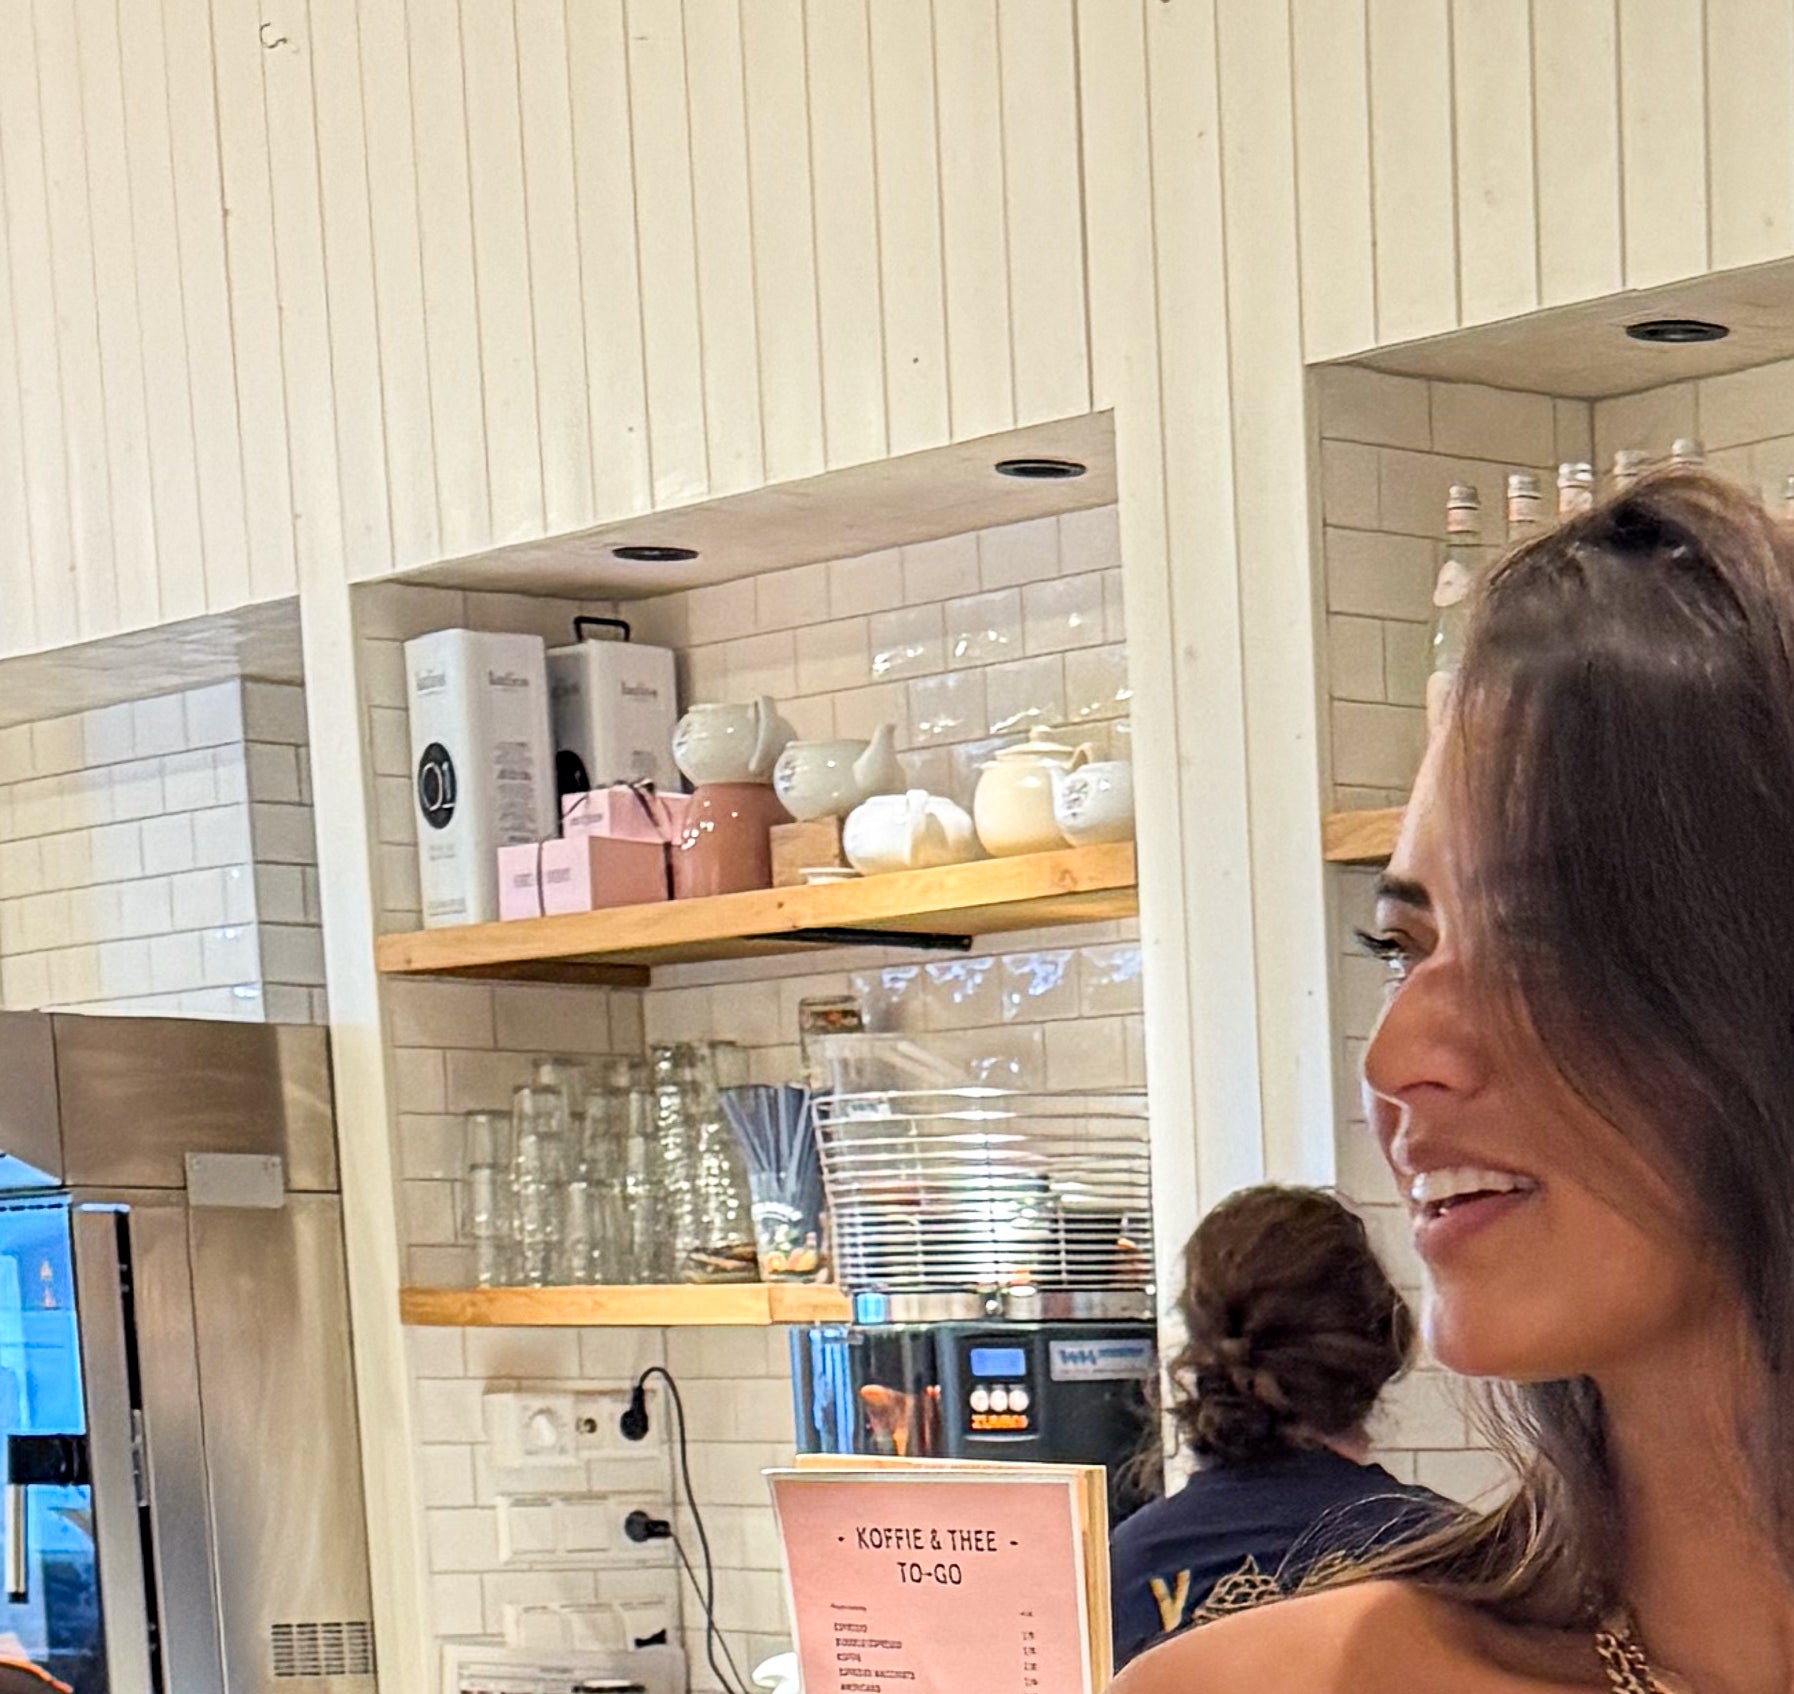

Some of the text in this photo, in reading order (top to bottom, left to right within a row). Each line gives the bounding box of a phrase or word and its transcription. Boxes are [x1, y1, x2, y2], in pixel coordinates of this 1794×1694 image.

[855, 1526, 998, 1552] KOFFIE & THEE
[896, 1561, 963, 1585] TO-GO
